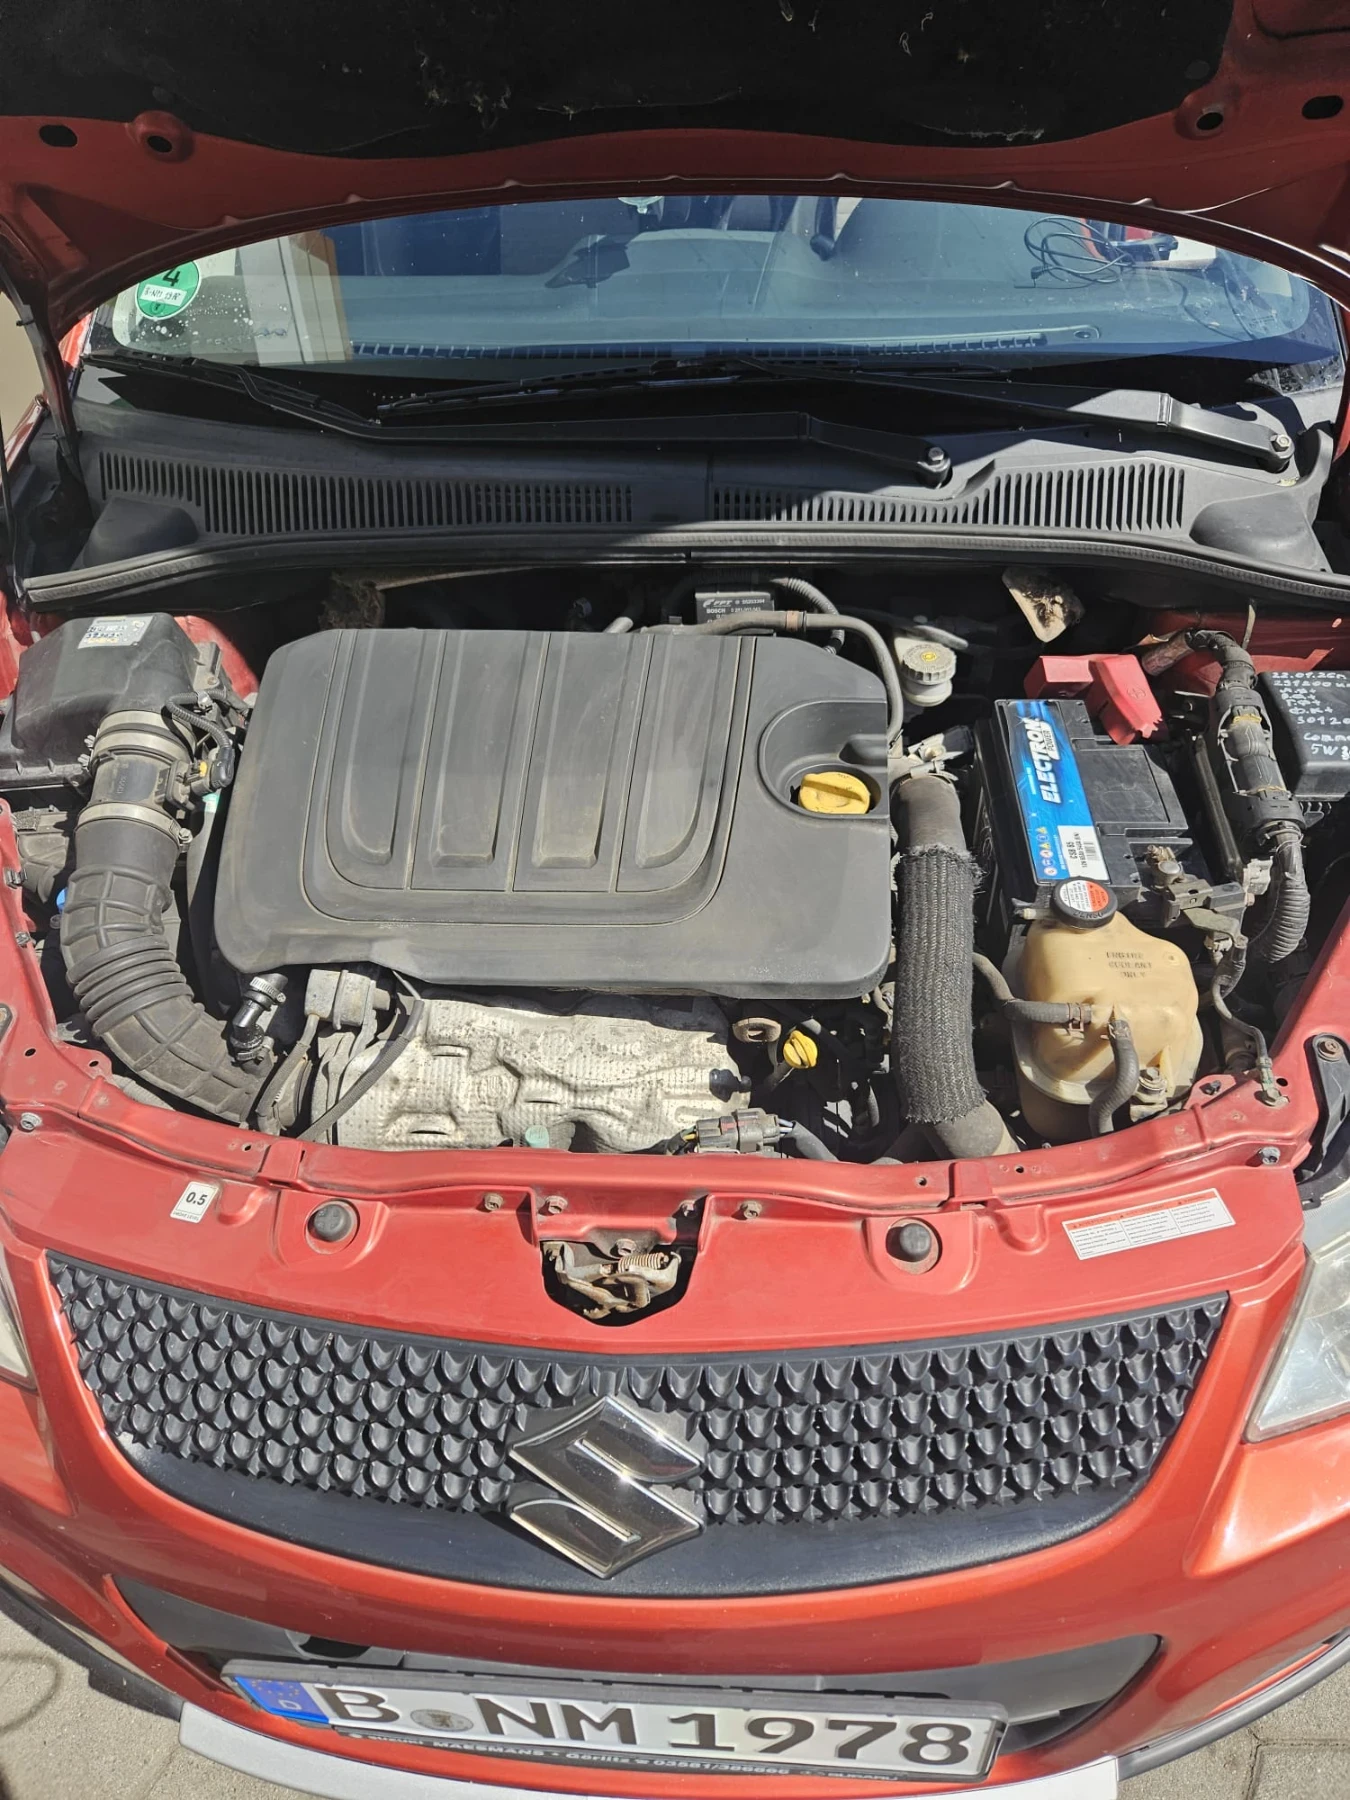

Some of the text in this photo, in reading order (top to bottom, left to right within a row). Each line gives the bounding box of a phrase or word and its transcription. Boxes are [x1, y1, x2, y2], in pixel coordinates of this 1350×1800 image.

[163, 266, 180, 287] 4
[1043, 730, 1054, 752] POWER
[1022, 717, 1061, 804] ELECTRON
[186, 1191, 208, 1206] 0.5
[278, 1699, 303, 1710] D
[314, 1686, 973, 1766] B NM 1978
[433, 1741, 545, 1757] MAESMANS
